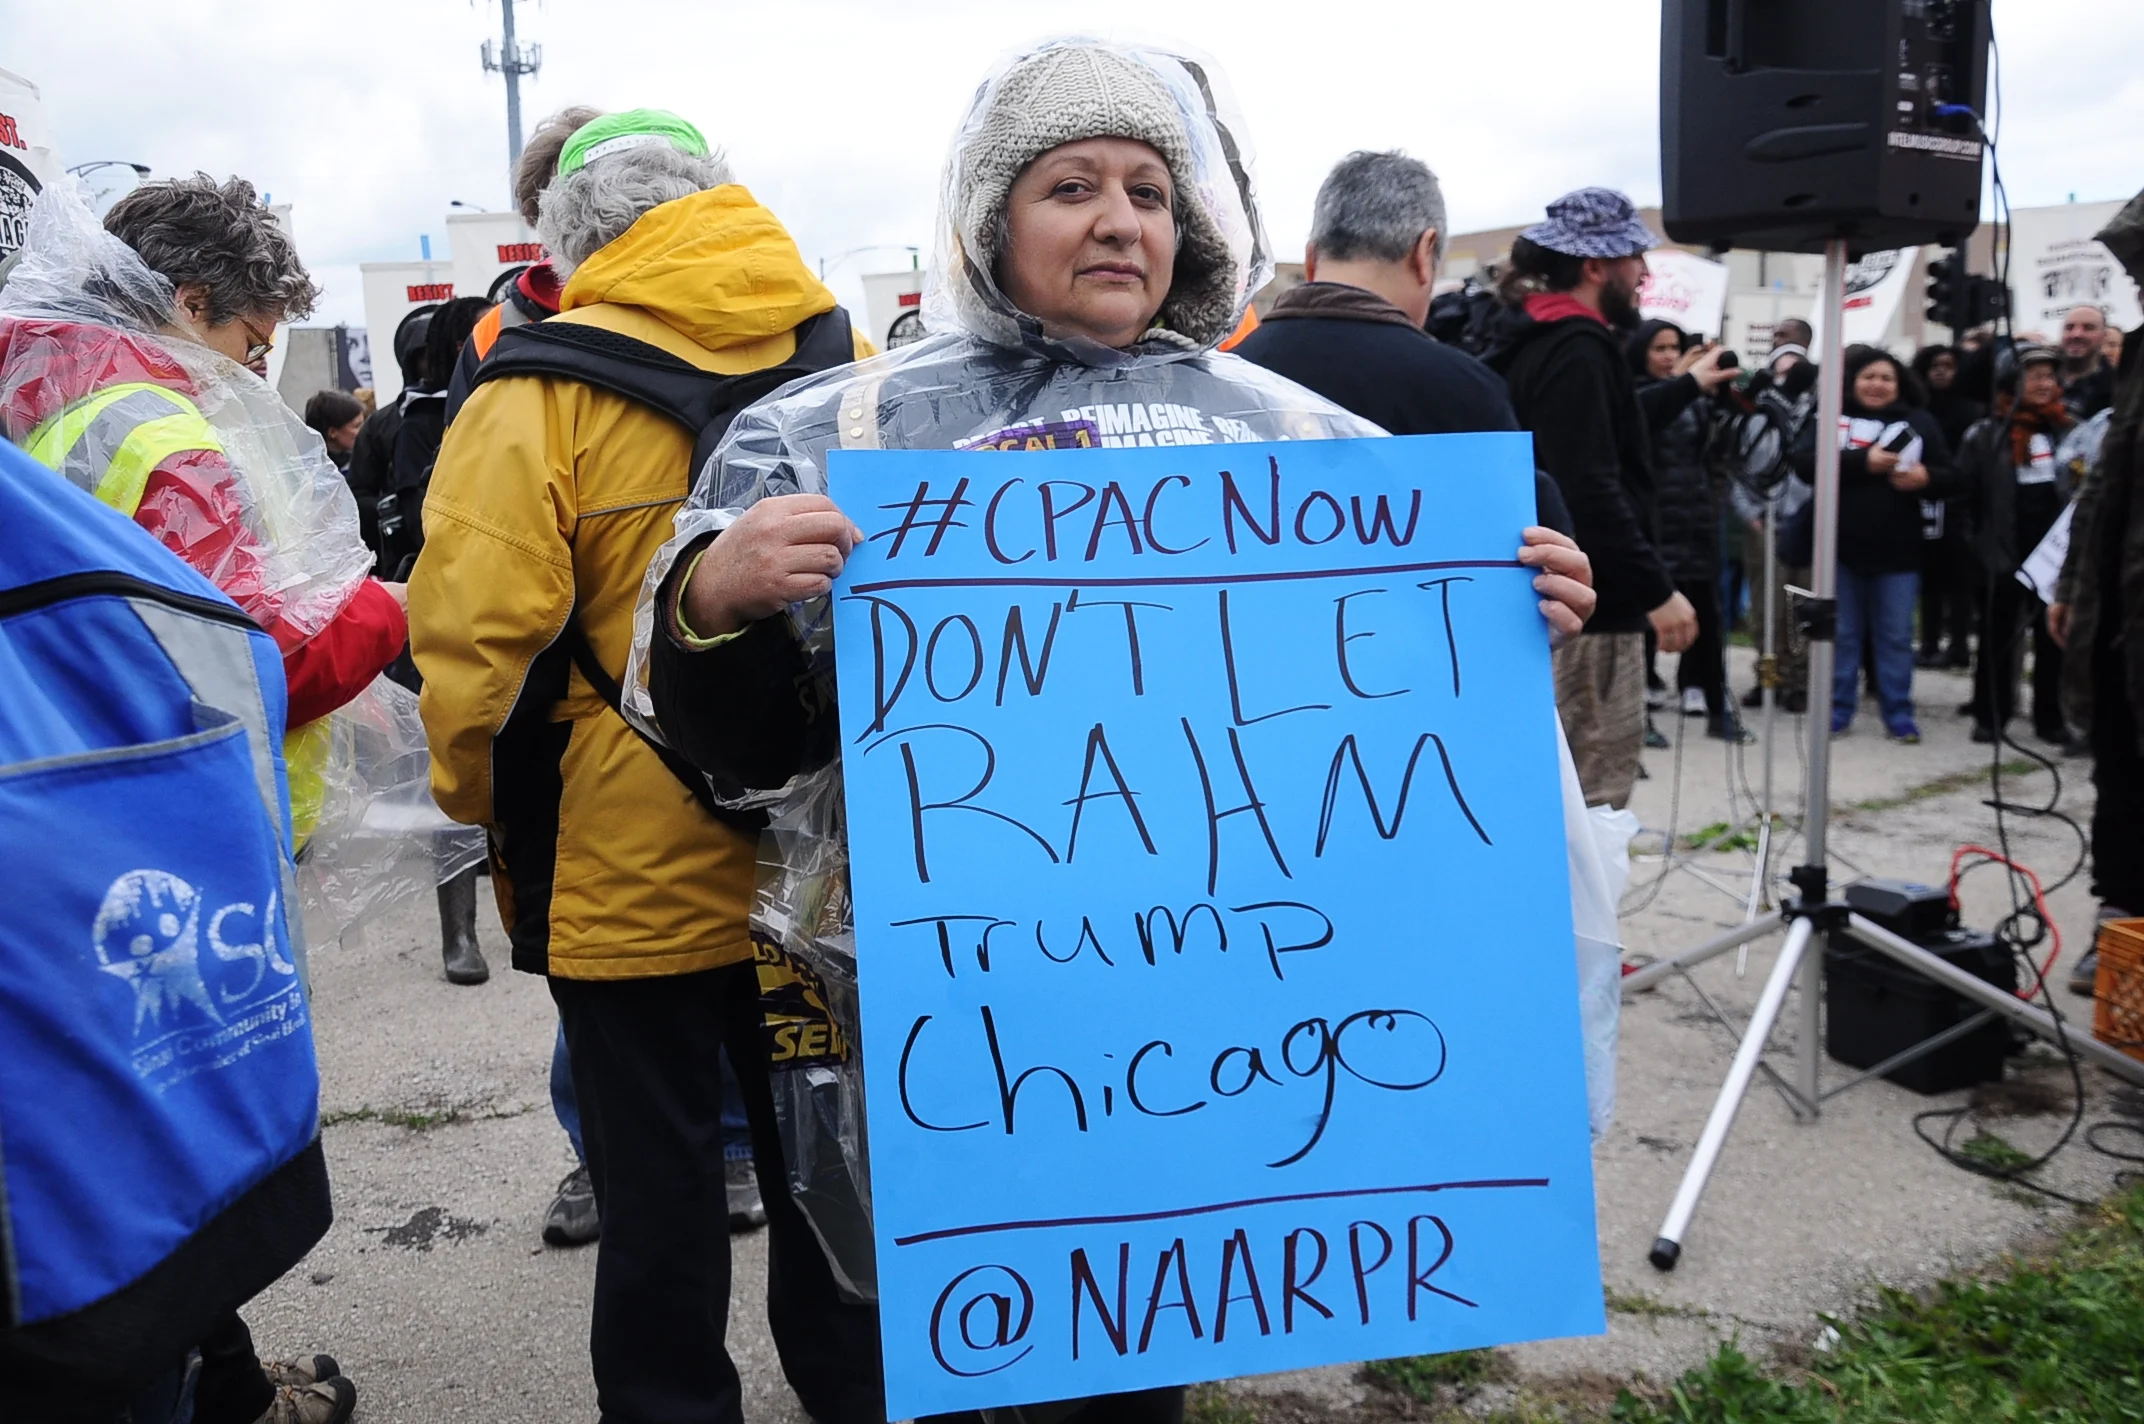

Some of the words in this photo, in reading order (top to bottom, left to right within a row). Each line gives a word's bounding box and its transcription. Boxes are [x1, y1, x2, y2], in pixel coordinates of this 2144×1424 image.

[497, 243, 543, 263] RESIS
[840, 589, 1174, 744] DON'T
[1218, 577, 1475, 726] LET
[864, 717, 1493, 896] RAHM
[899, 1004, 1446, 1168] Chicago
[930, 1214, 1479, 1377] @NAARPR
